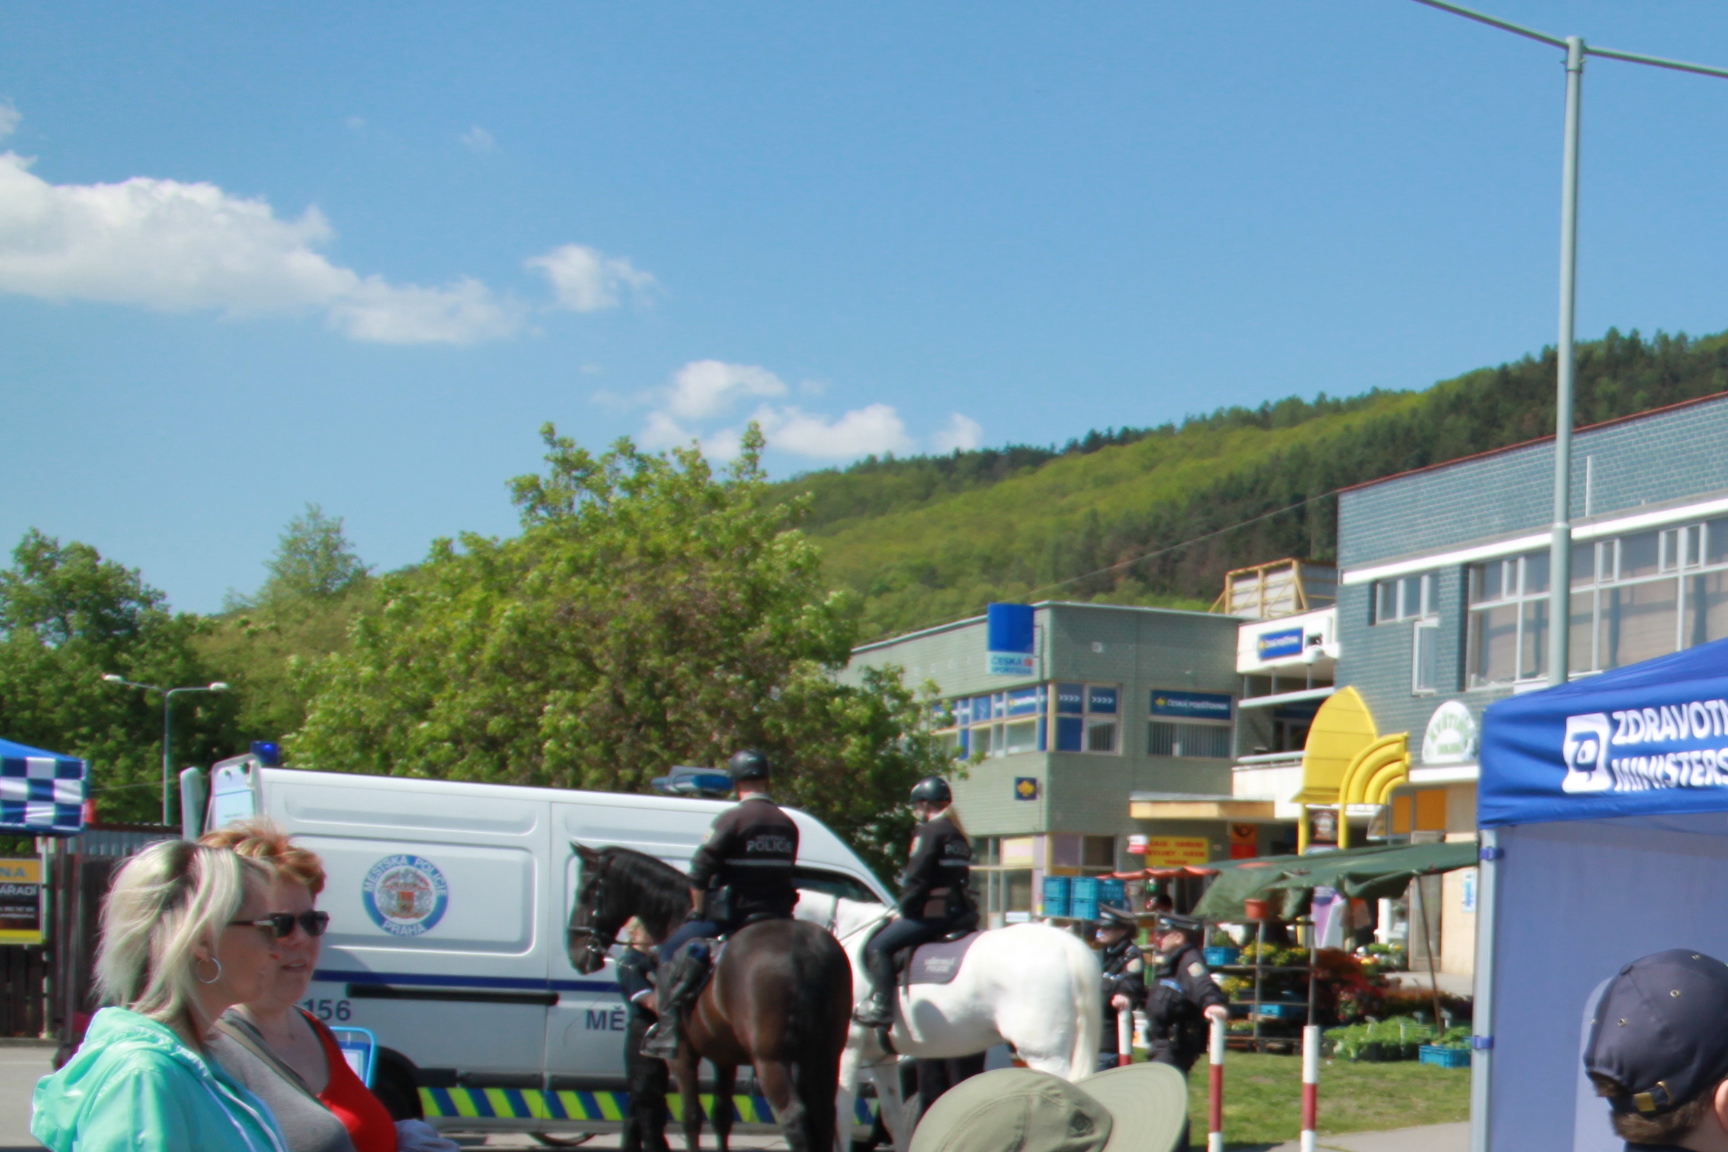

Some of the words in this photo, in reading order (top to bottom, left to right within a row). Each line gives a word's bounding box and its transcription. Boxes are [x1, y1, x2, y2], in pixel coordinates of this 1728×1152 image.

[383, 920, 427, 936] PRAHA
[305, 999, 352, 1022] 156
[585, 1005, 625, 1031] MĚ
